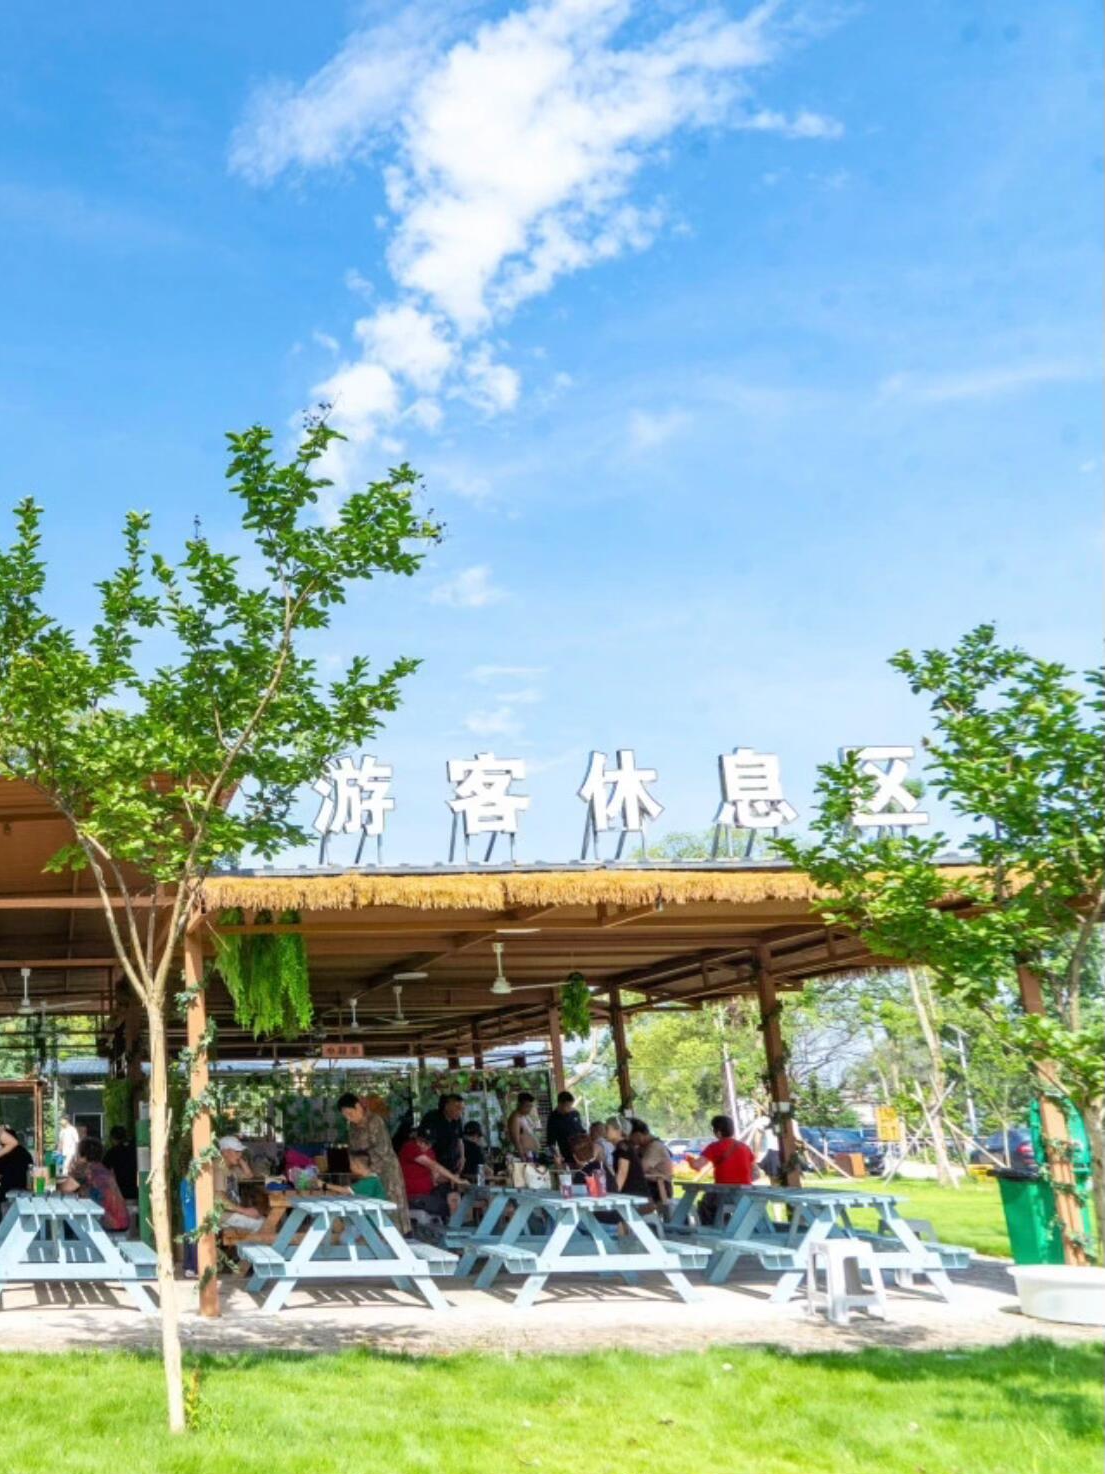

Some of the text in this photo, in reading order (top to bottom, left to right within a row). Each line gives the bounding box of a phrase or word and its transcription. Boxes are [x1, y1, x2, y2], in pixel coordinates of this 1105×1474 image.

[312, 746, 930, 835] 游客休息区
